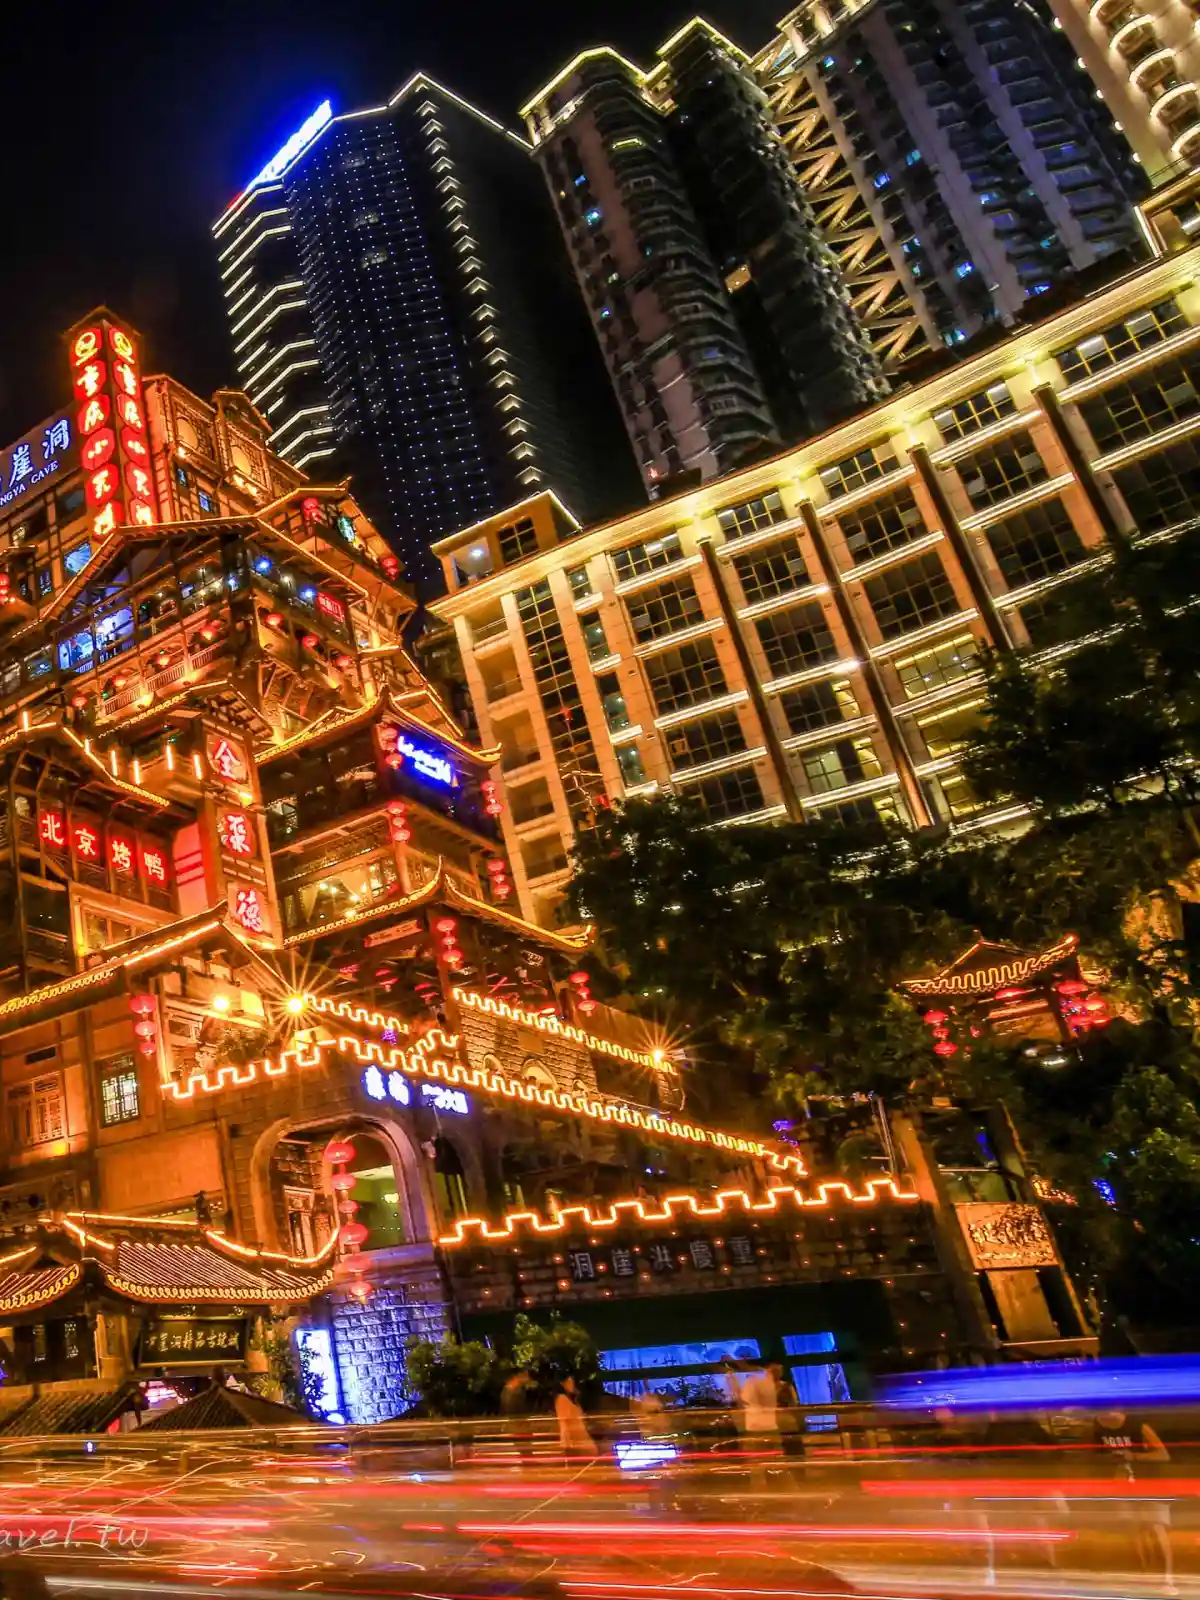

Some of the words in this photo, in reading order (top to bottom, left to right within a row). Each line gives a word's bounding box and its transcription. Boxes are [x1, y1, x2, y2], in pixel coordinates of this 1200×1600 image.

[30, 460, 60, 484] CAVE
[41, 814, 165, 881] 北京烤鸭
